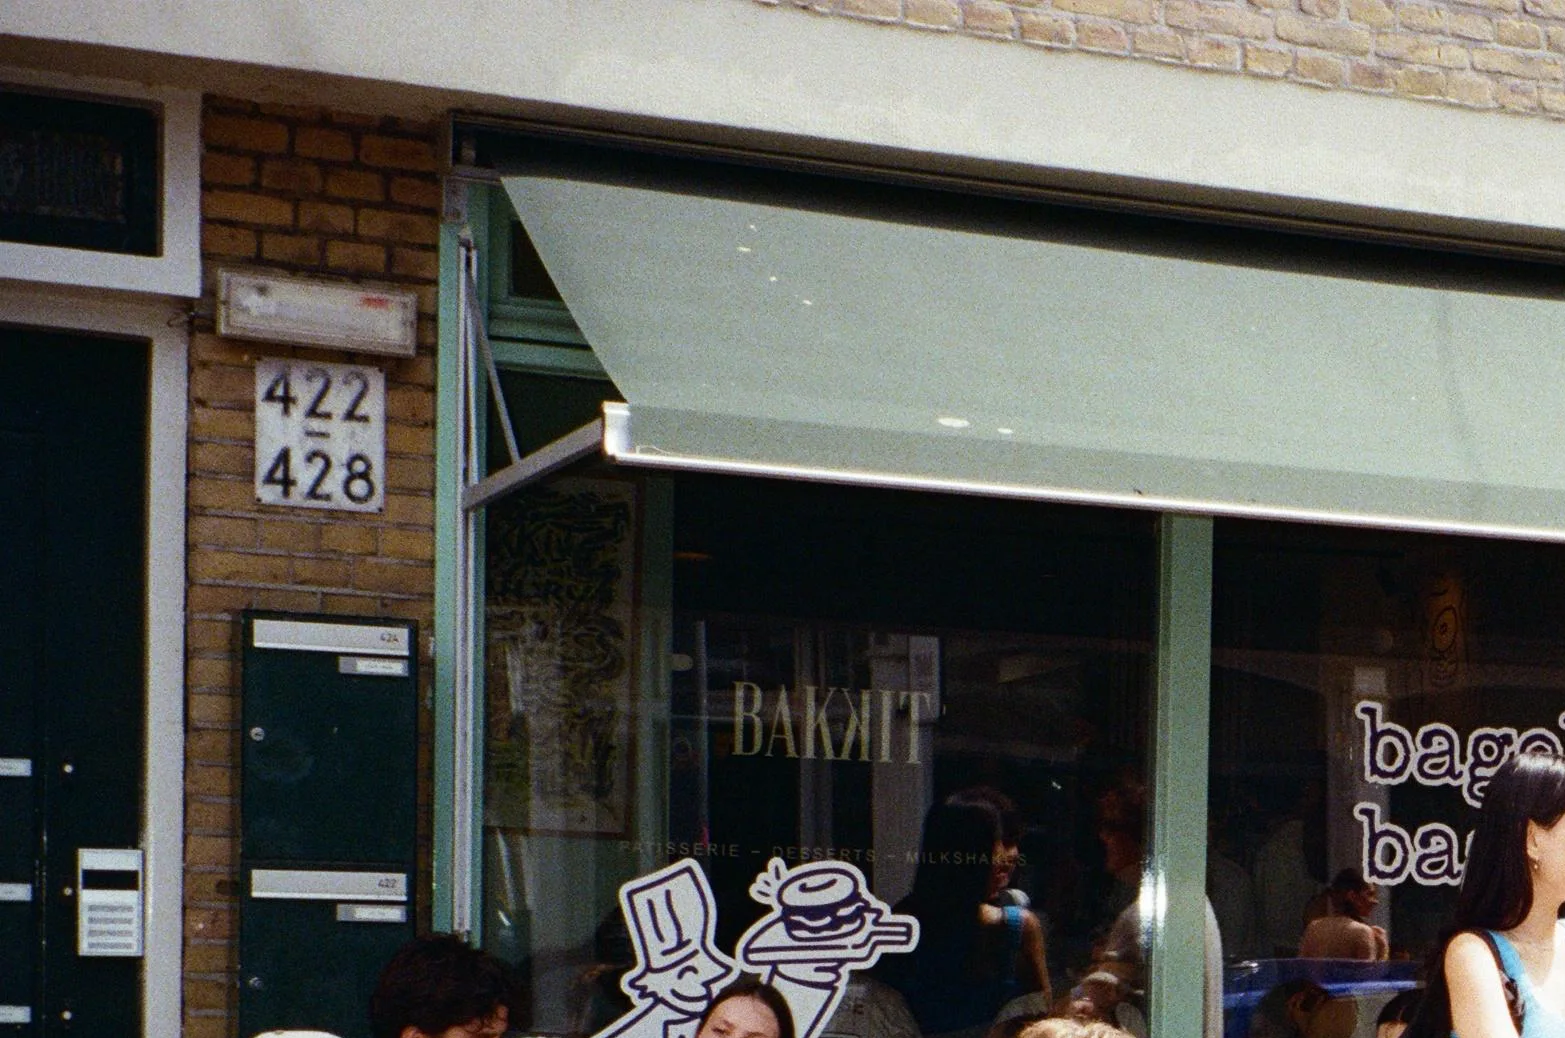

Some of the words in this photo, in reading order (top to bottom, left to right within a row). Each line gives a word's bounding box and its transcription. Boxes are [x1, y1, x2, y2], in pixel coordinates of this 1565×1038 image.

[261, 367, 370, 423] 422
[262, 445, 375, 504] 428
[772, 845, 876, 862] DESSERTS
[906, 850, 1028, 867] MILKSHAKES
